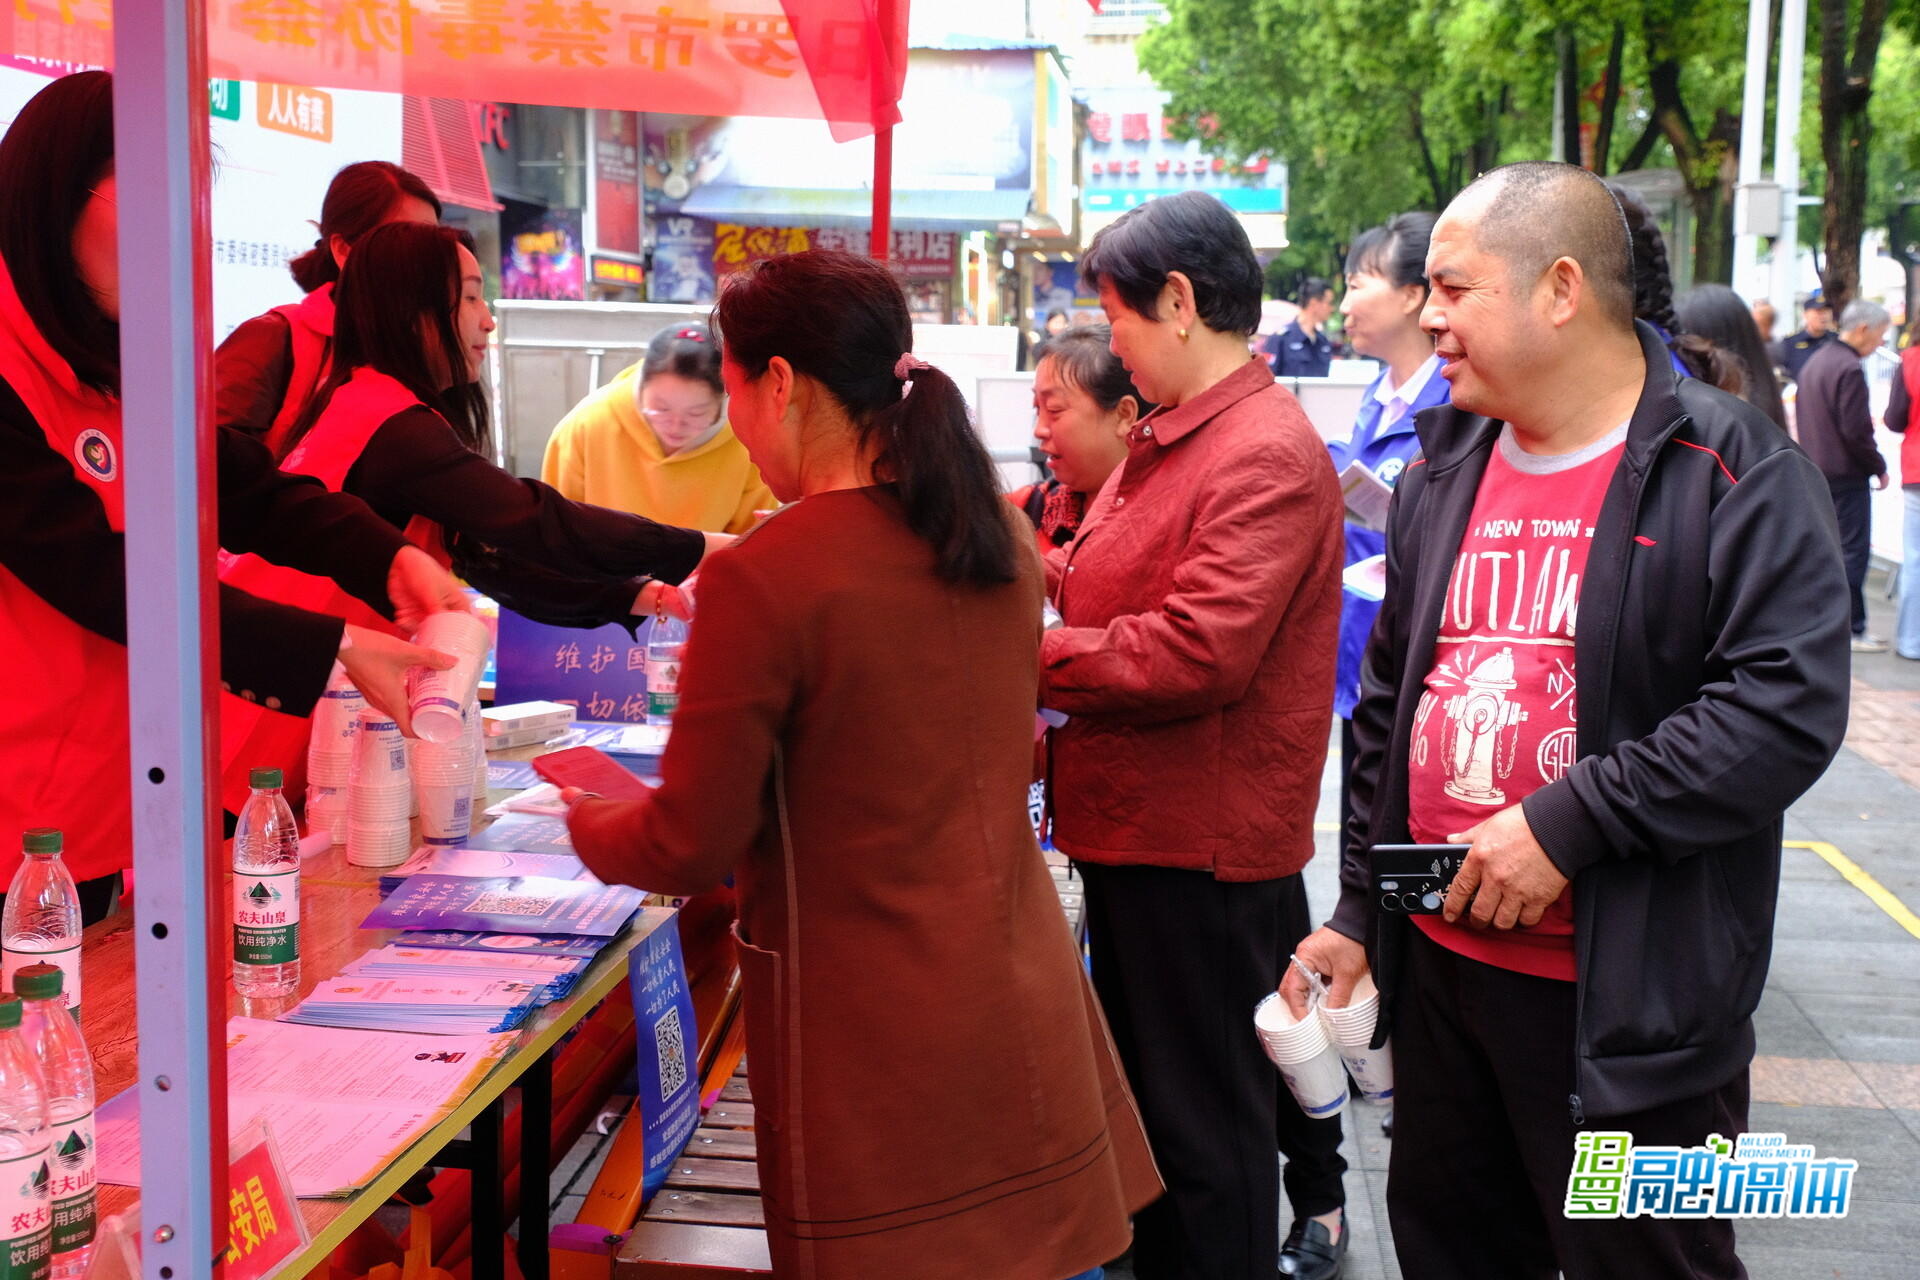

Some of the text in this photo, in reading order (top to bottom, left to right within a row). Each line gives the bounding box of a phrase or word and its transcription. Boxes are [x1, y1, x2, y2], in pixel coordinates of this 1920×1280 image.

[1483, 519, 1582, 539] NEW TOWN
[1440, 545, 1579, 637] UTLAW
[554, 641, 648, 674] 维护国
[238, 911, 286, 925] 农夫山泉
[238, 935, 287, 947] 饮用纯净水
